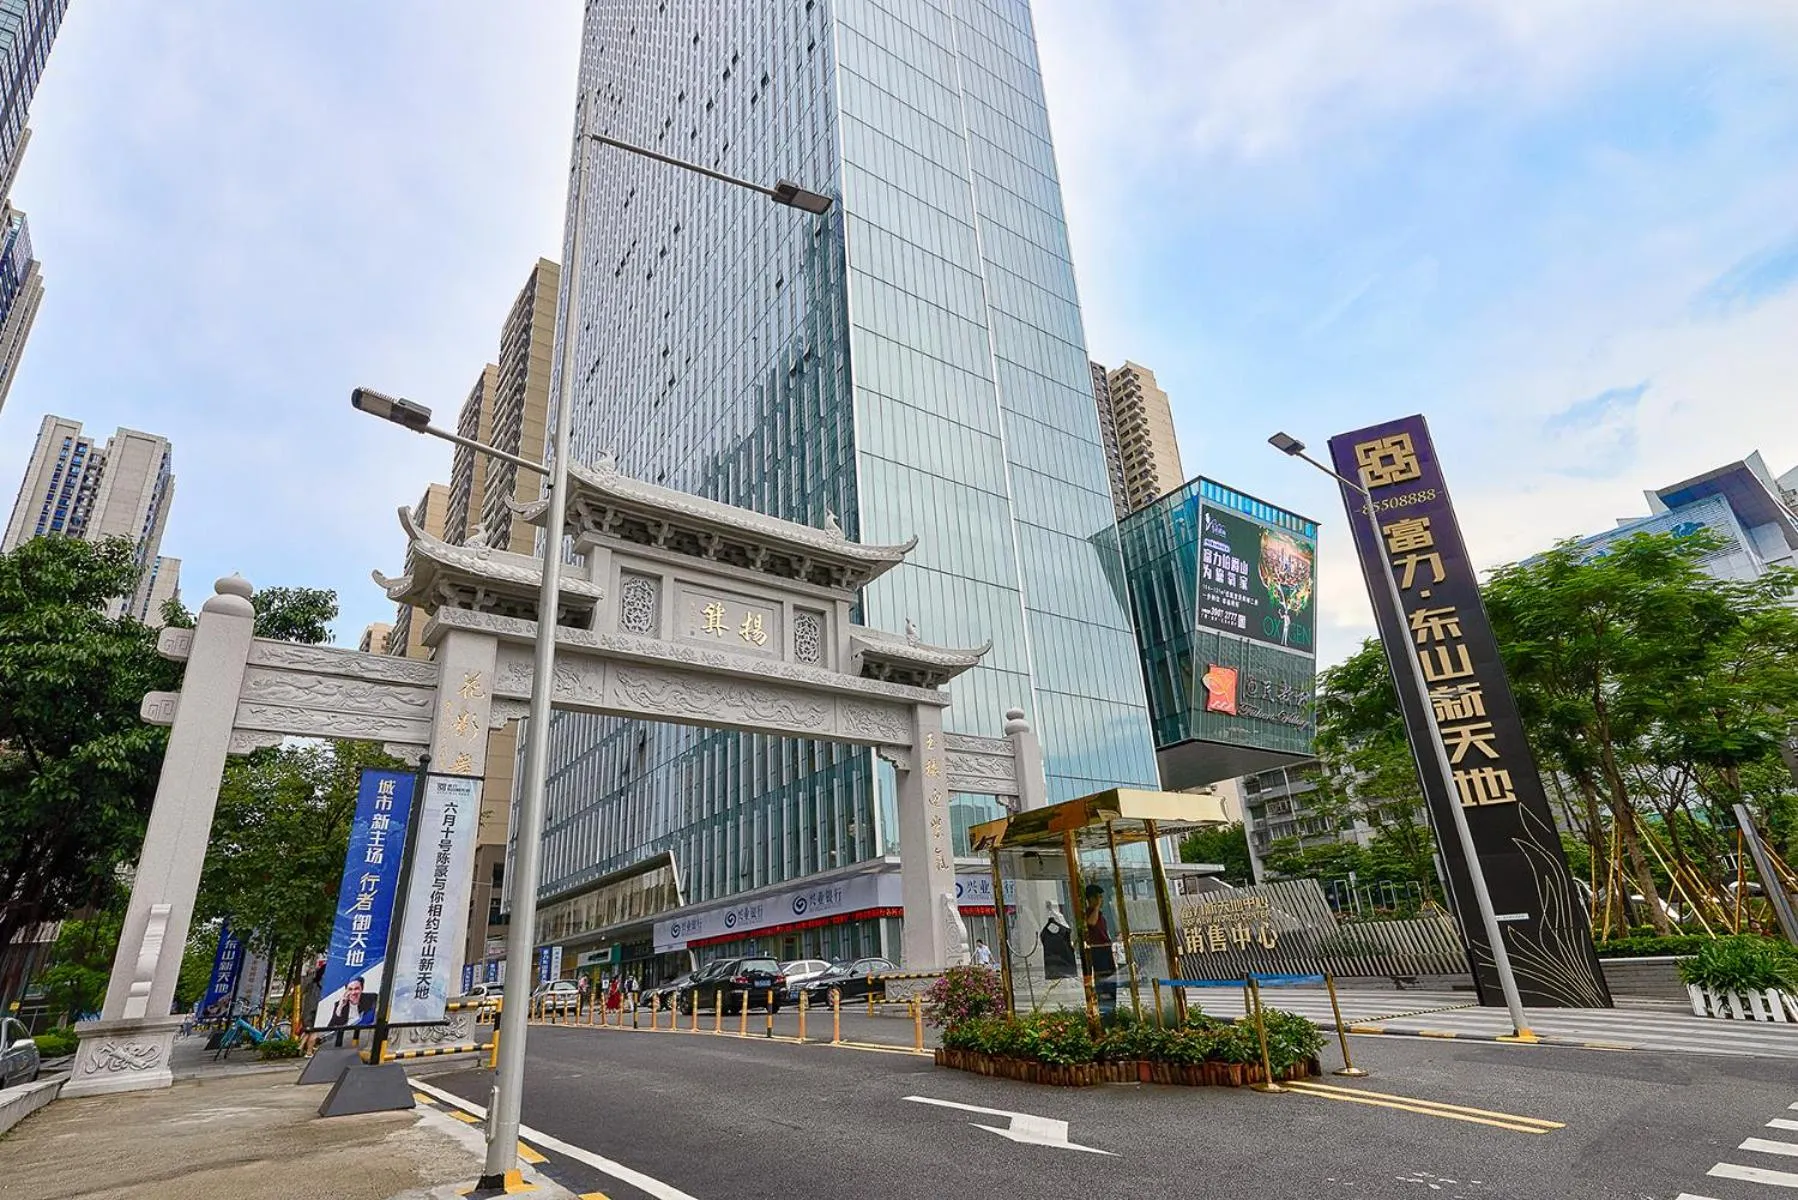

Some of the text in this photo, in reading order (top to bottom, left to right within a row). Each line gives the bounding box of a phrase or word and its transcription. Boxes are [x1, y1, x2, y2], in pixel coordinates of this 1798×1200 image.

[1263, 615, 1312, 646] OXGEN
[344, 779, 397, 968] 城市新主场 行者御天地
[966, 879, 1014, 894] 兴业行
[413, 801, 459, 1000] 六月十号陈豪与你相约东山新天地
[737, 903, 763, 922] 兴业银行
[809, 887, 842, 908] 兴业银行
[1184, 922, 1279, 953] 销售中心
